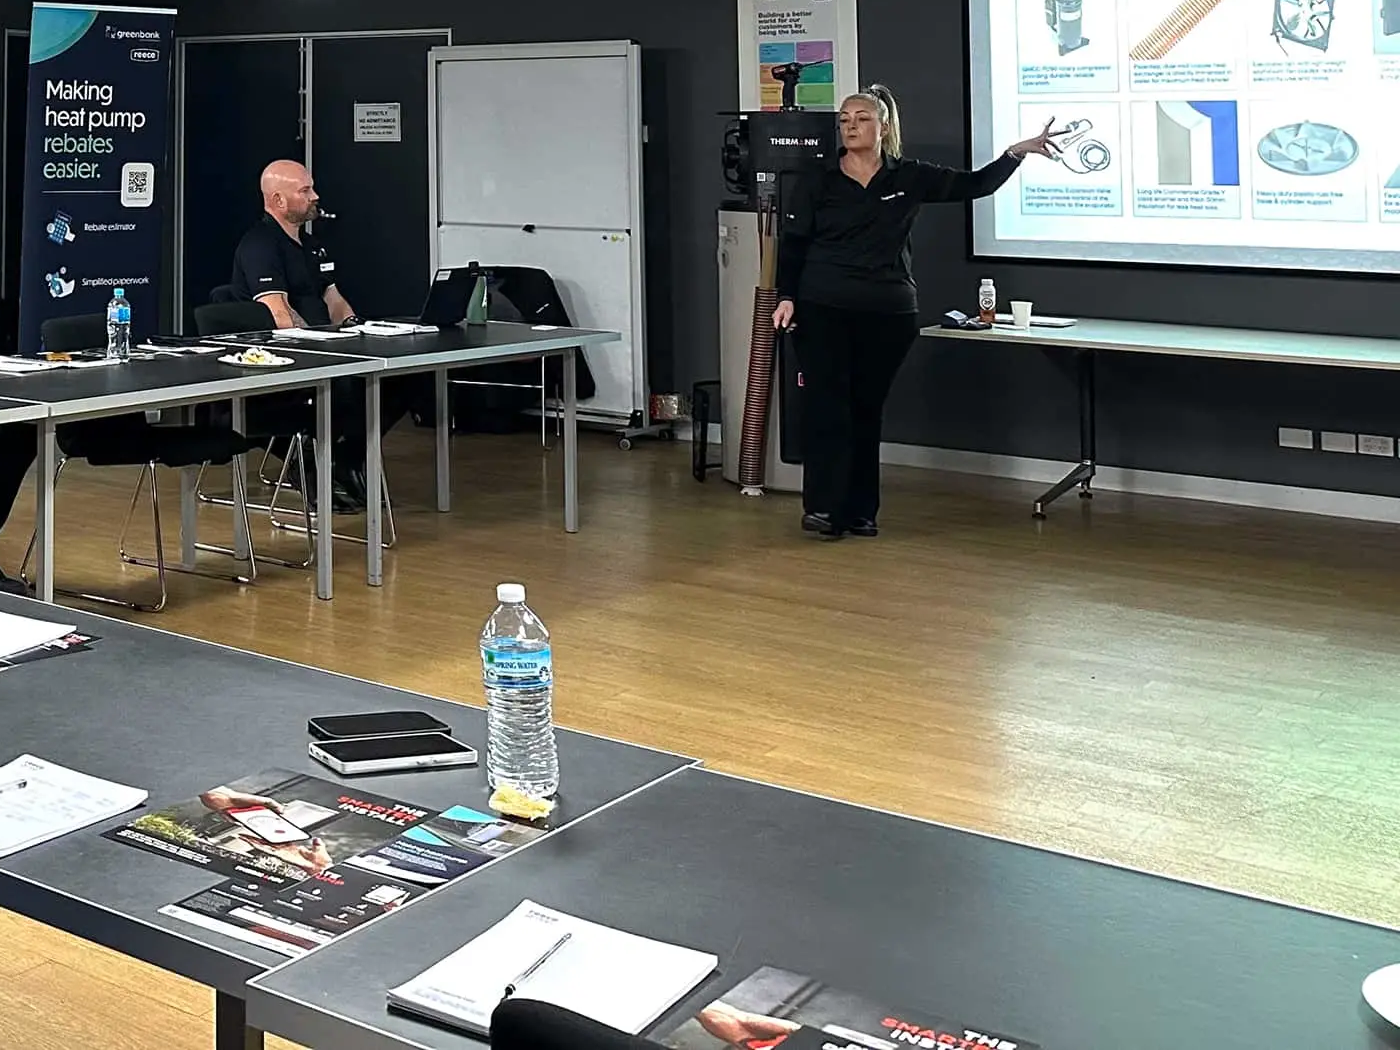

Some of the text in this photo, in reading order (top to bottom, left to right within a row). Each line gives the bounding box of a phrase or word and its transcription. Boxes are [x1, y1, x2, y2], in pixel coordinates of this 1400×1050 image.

[117, 30, 161, 40] greenbank
[133, 50, 156, 59] reece
[45, 79, 114, 106] Making
[44, 105, 146, 133] heat pump
[43, 133, 114, 154] rebates
[43, 158, 101, 179] easier.
[84, 223, 137, 231] Rebate estimator
[81, 276, 150, 287] Simplified paperwork
